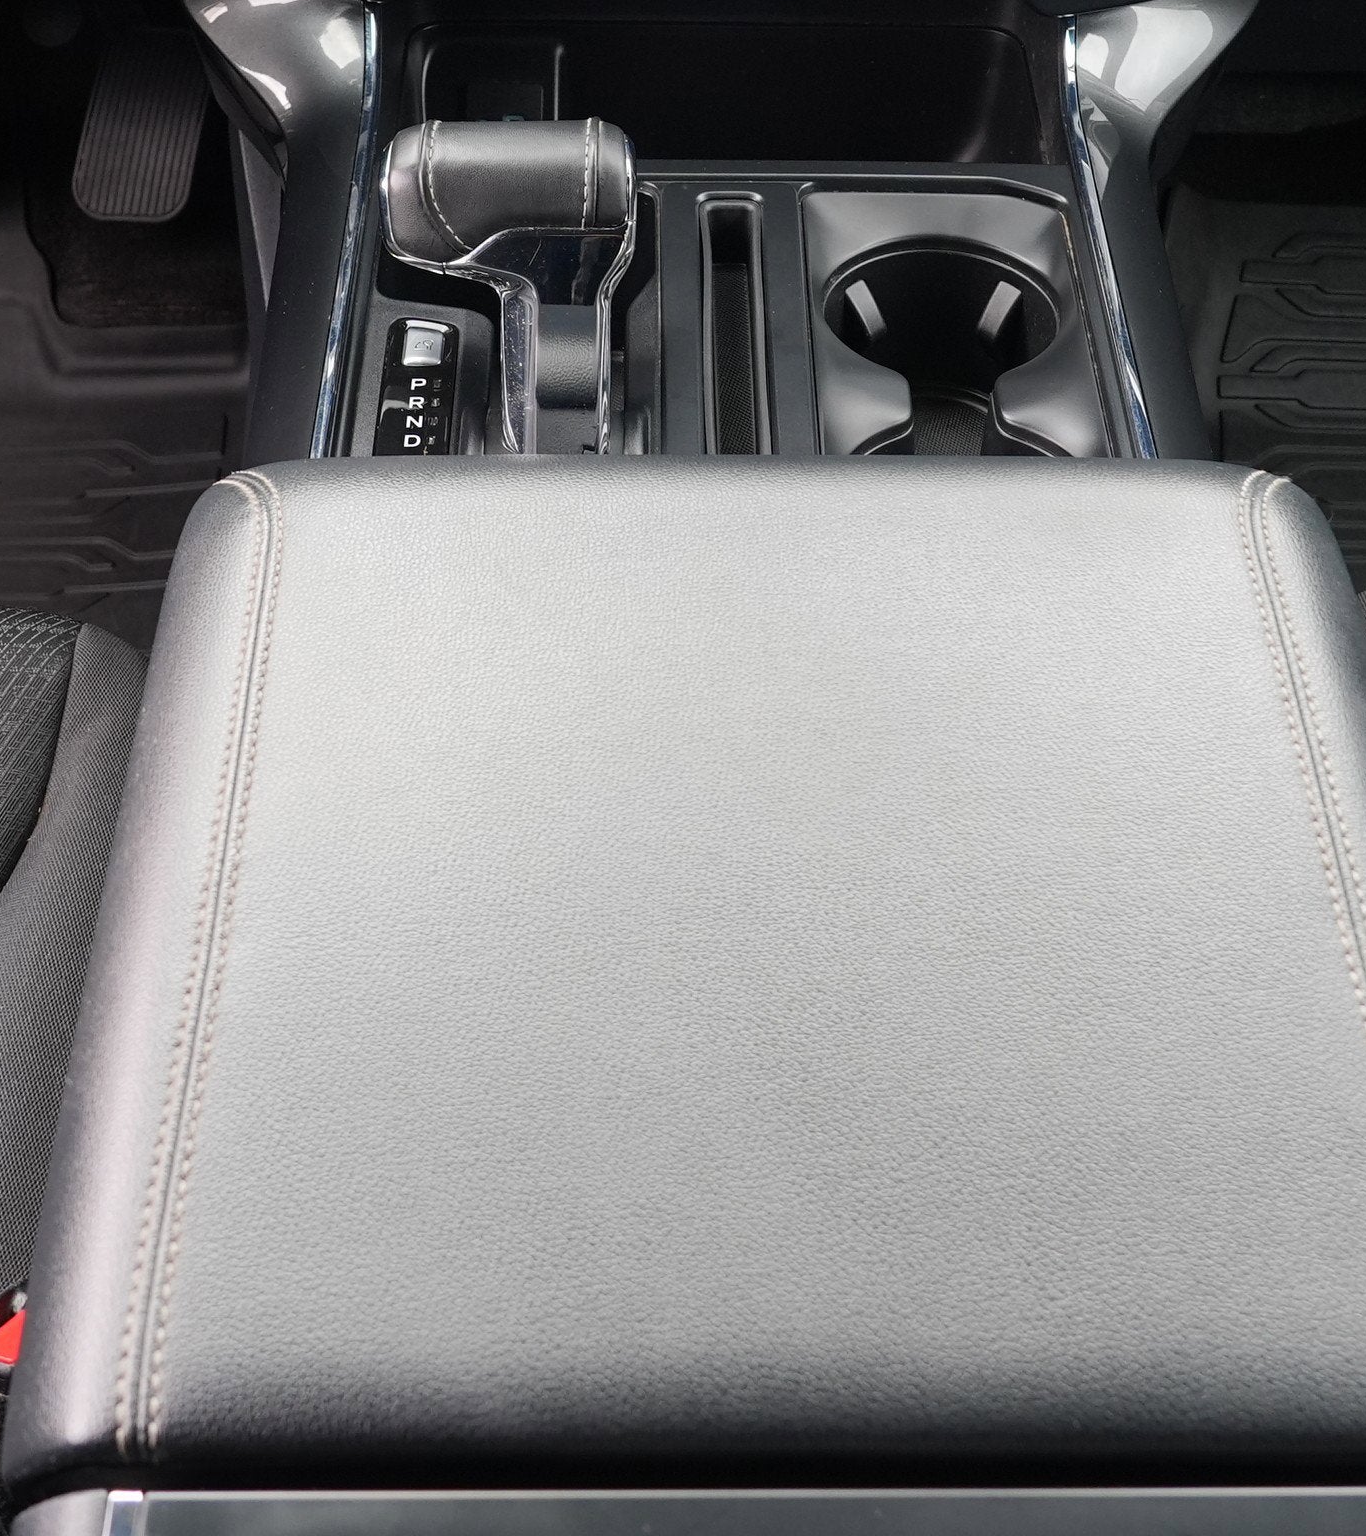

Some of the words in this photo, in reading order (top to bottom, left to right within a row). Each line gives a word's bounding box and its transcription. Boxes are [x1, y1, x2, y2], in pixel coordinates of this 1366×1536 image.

[410, 377, 427, 391] P
[408, 396, 425, 409] R
[405, 415, 424, 429] N
[403, 434, 422, 448] D
